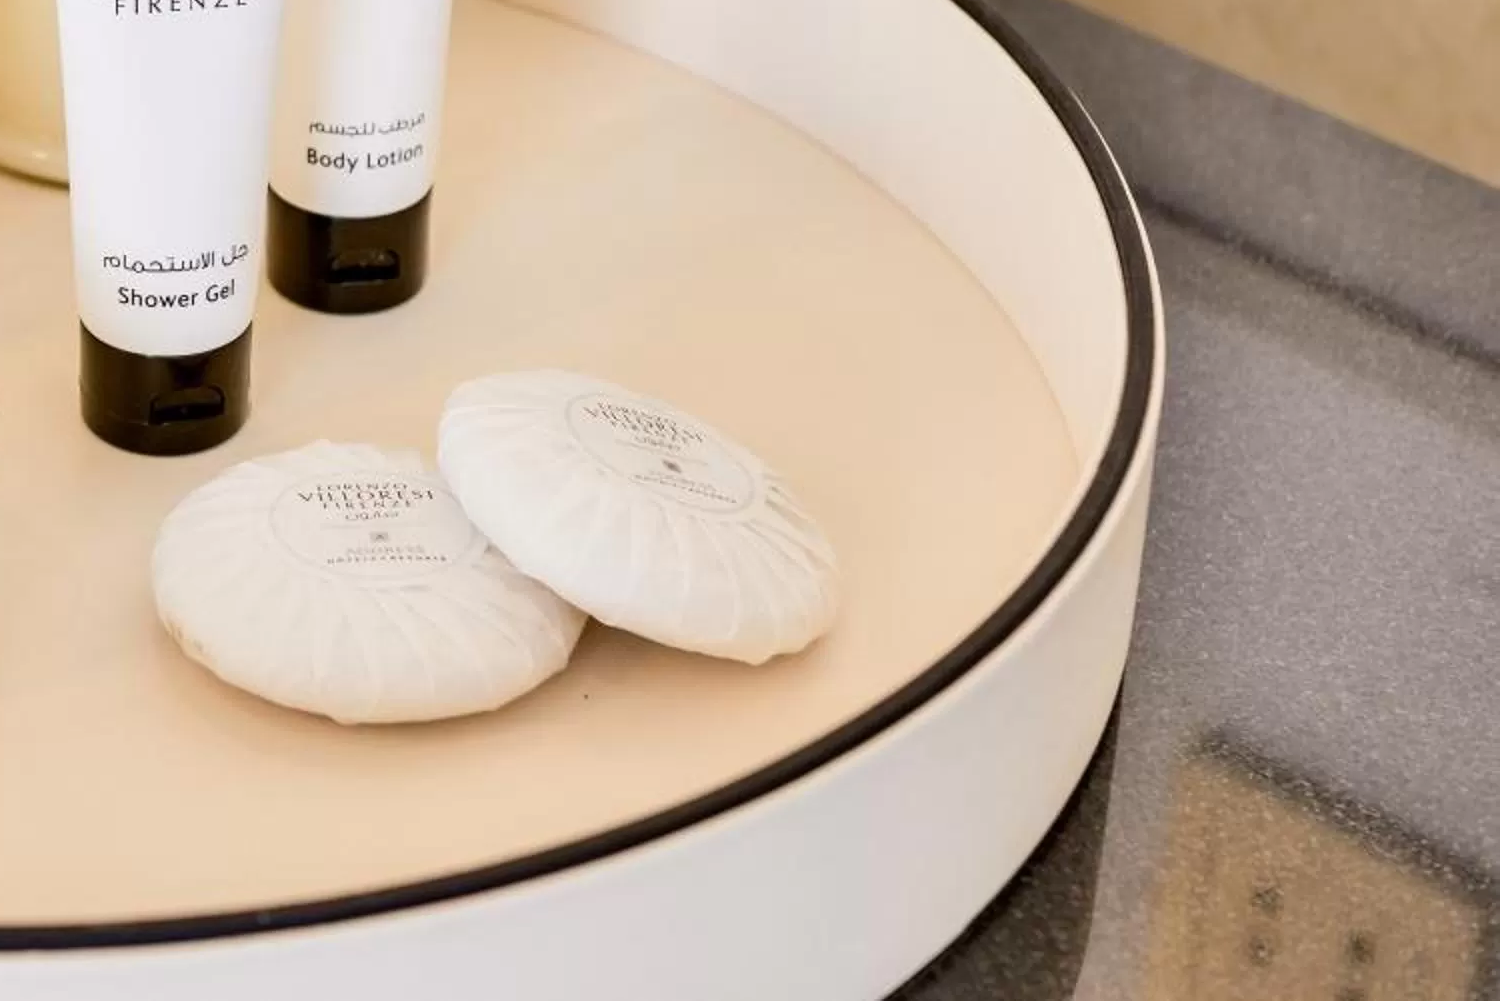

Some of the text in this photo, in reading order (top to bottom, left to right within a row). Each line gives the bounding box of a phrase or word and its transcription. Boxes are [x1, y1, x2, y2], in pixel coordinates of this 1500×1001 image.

[306, 143, 424, 174] Body Lotion
[102, 251, 216, 274] الاستحمام
[118, 278, 236, 309] Shower Gel
[297, 489, 435, 502] VILLORESI
